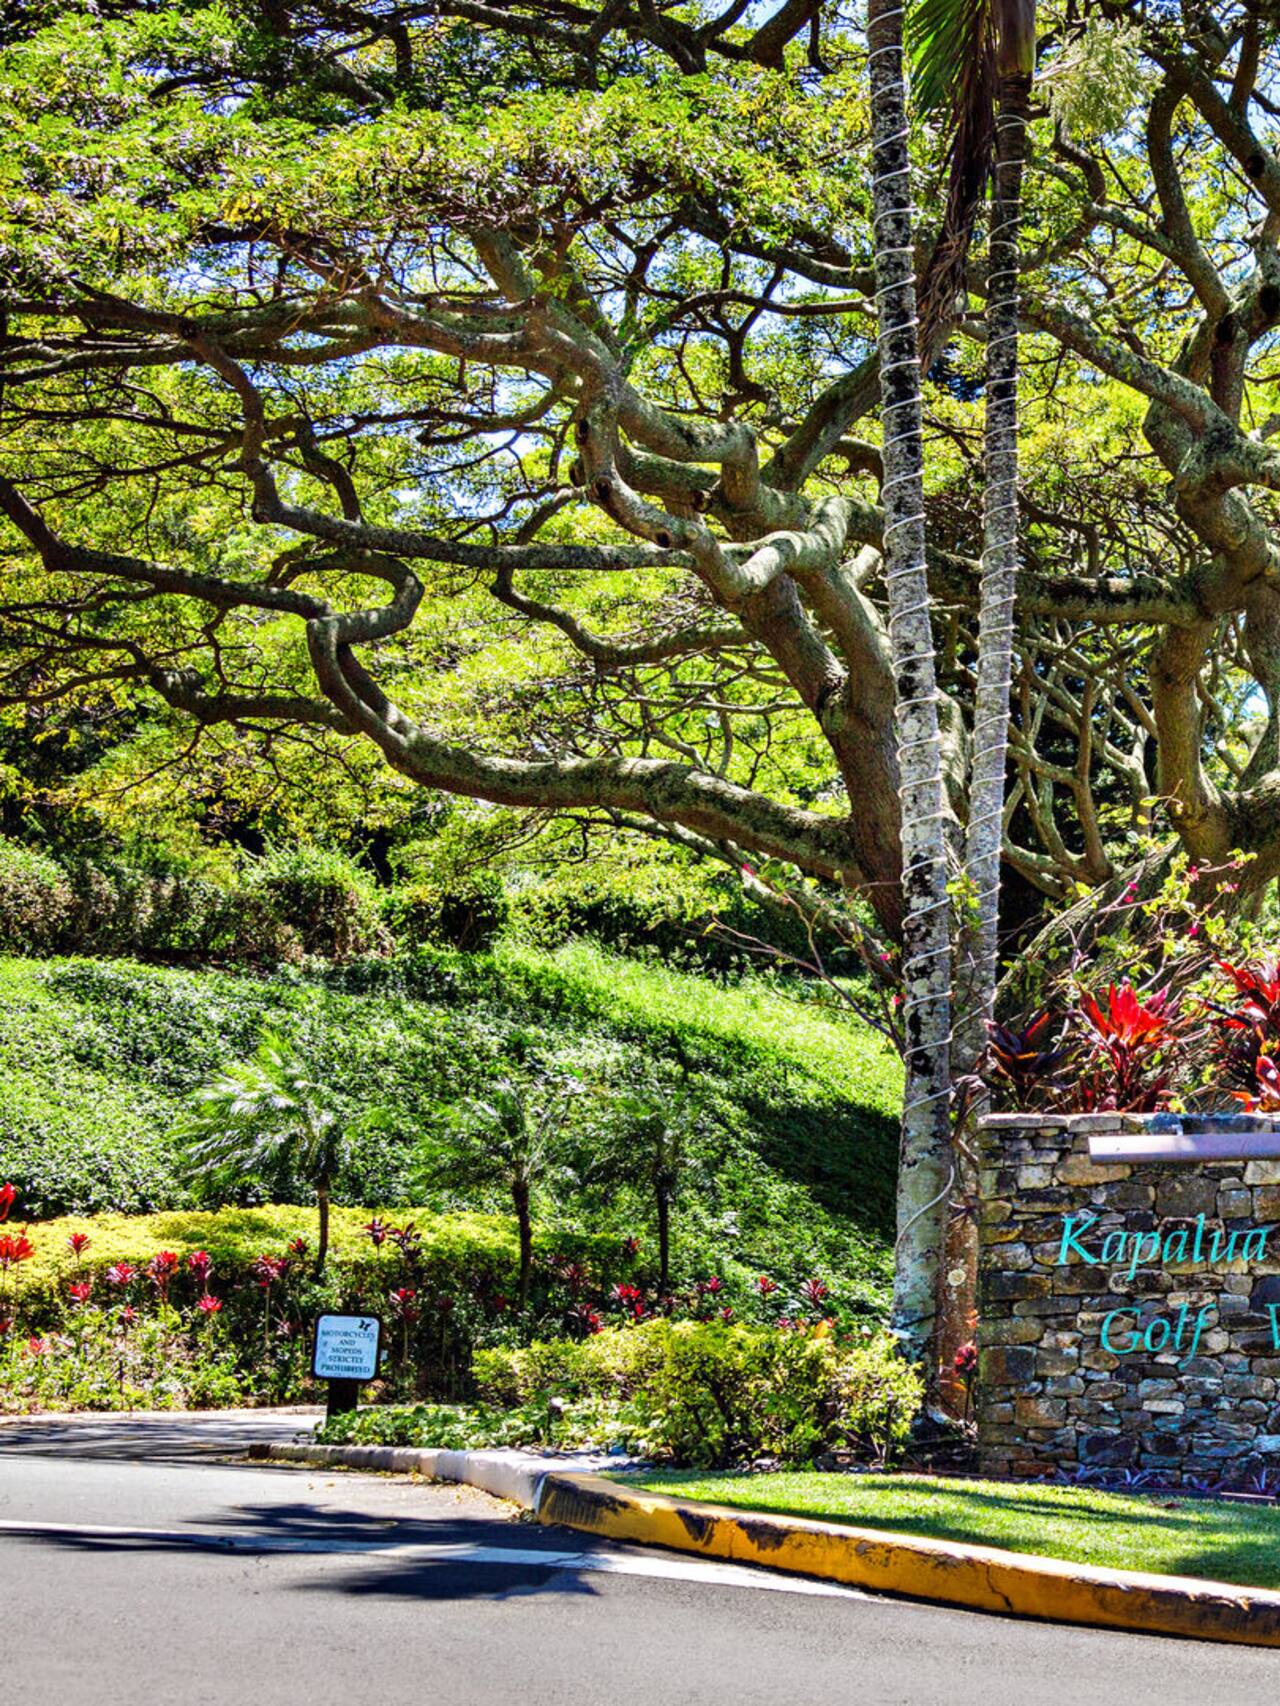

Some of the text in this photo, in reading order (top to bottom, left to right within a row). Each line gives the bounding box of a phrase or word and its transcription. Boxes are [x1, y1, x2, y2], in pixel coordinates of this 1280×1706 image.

[1058, 1213, 1268, 1281] Kapalua
[321, 1364, 370, 1373] PROHIBITED
[1101, 1303, 1216, 1370] Golf
